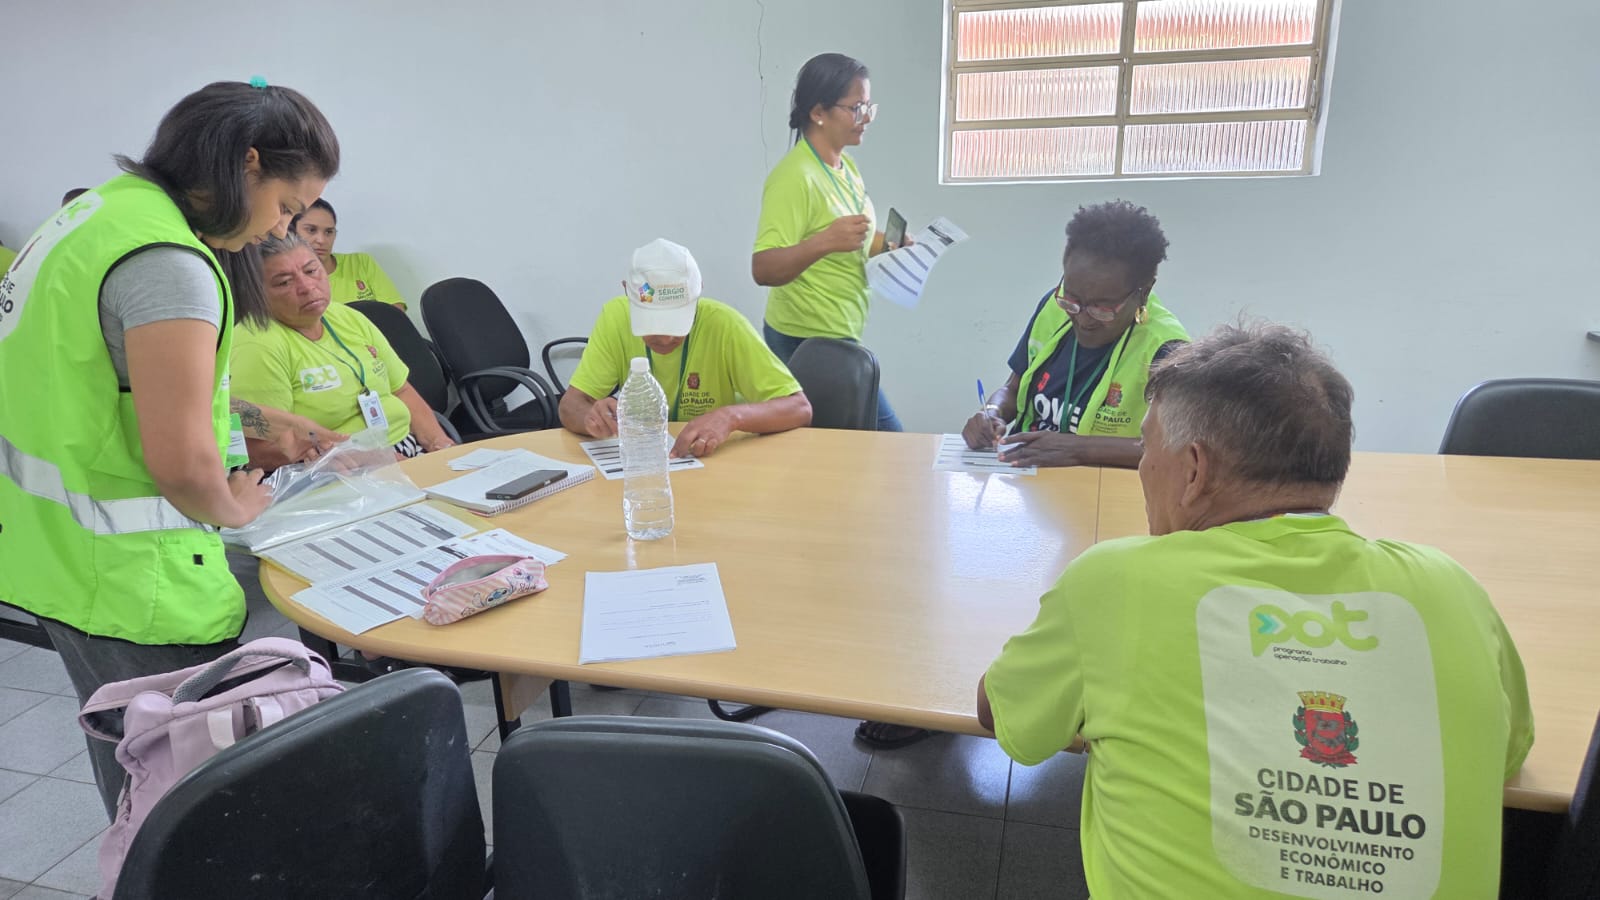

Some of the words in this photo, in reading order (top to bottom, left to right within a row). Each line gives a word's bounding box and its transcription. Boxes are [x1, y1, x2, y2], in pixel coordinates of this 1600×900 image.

[1103, 415, 1131, 424] PAULO
[1248, 600, 1379, 657] pot
[1273, 646, 1313, 656] programa
[1274, 653, 1311, 663] operação
[1312, 657, 1348, 666] trabalho
[1257, 768, 1359, 800] CIDADE
[1368, 781, 1405, 805] DE
[1234, 790, 1308, 825] SÃO
[1315, 803, 1426, 840] PAULO
[1249, 825, 1414, 861] DESENVOLVIMENTO
[1280, 849, 1386, 875] ECONÔMICO
[1281, 867, 1290, 880] E
[1295, 869, 1384, 894] TRABALHO
